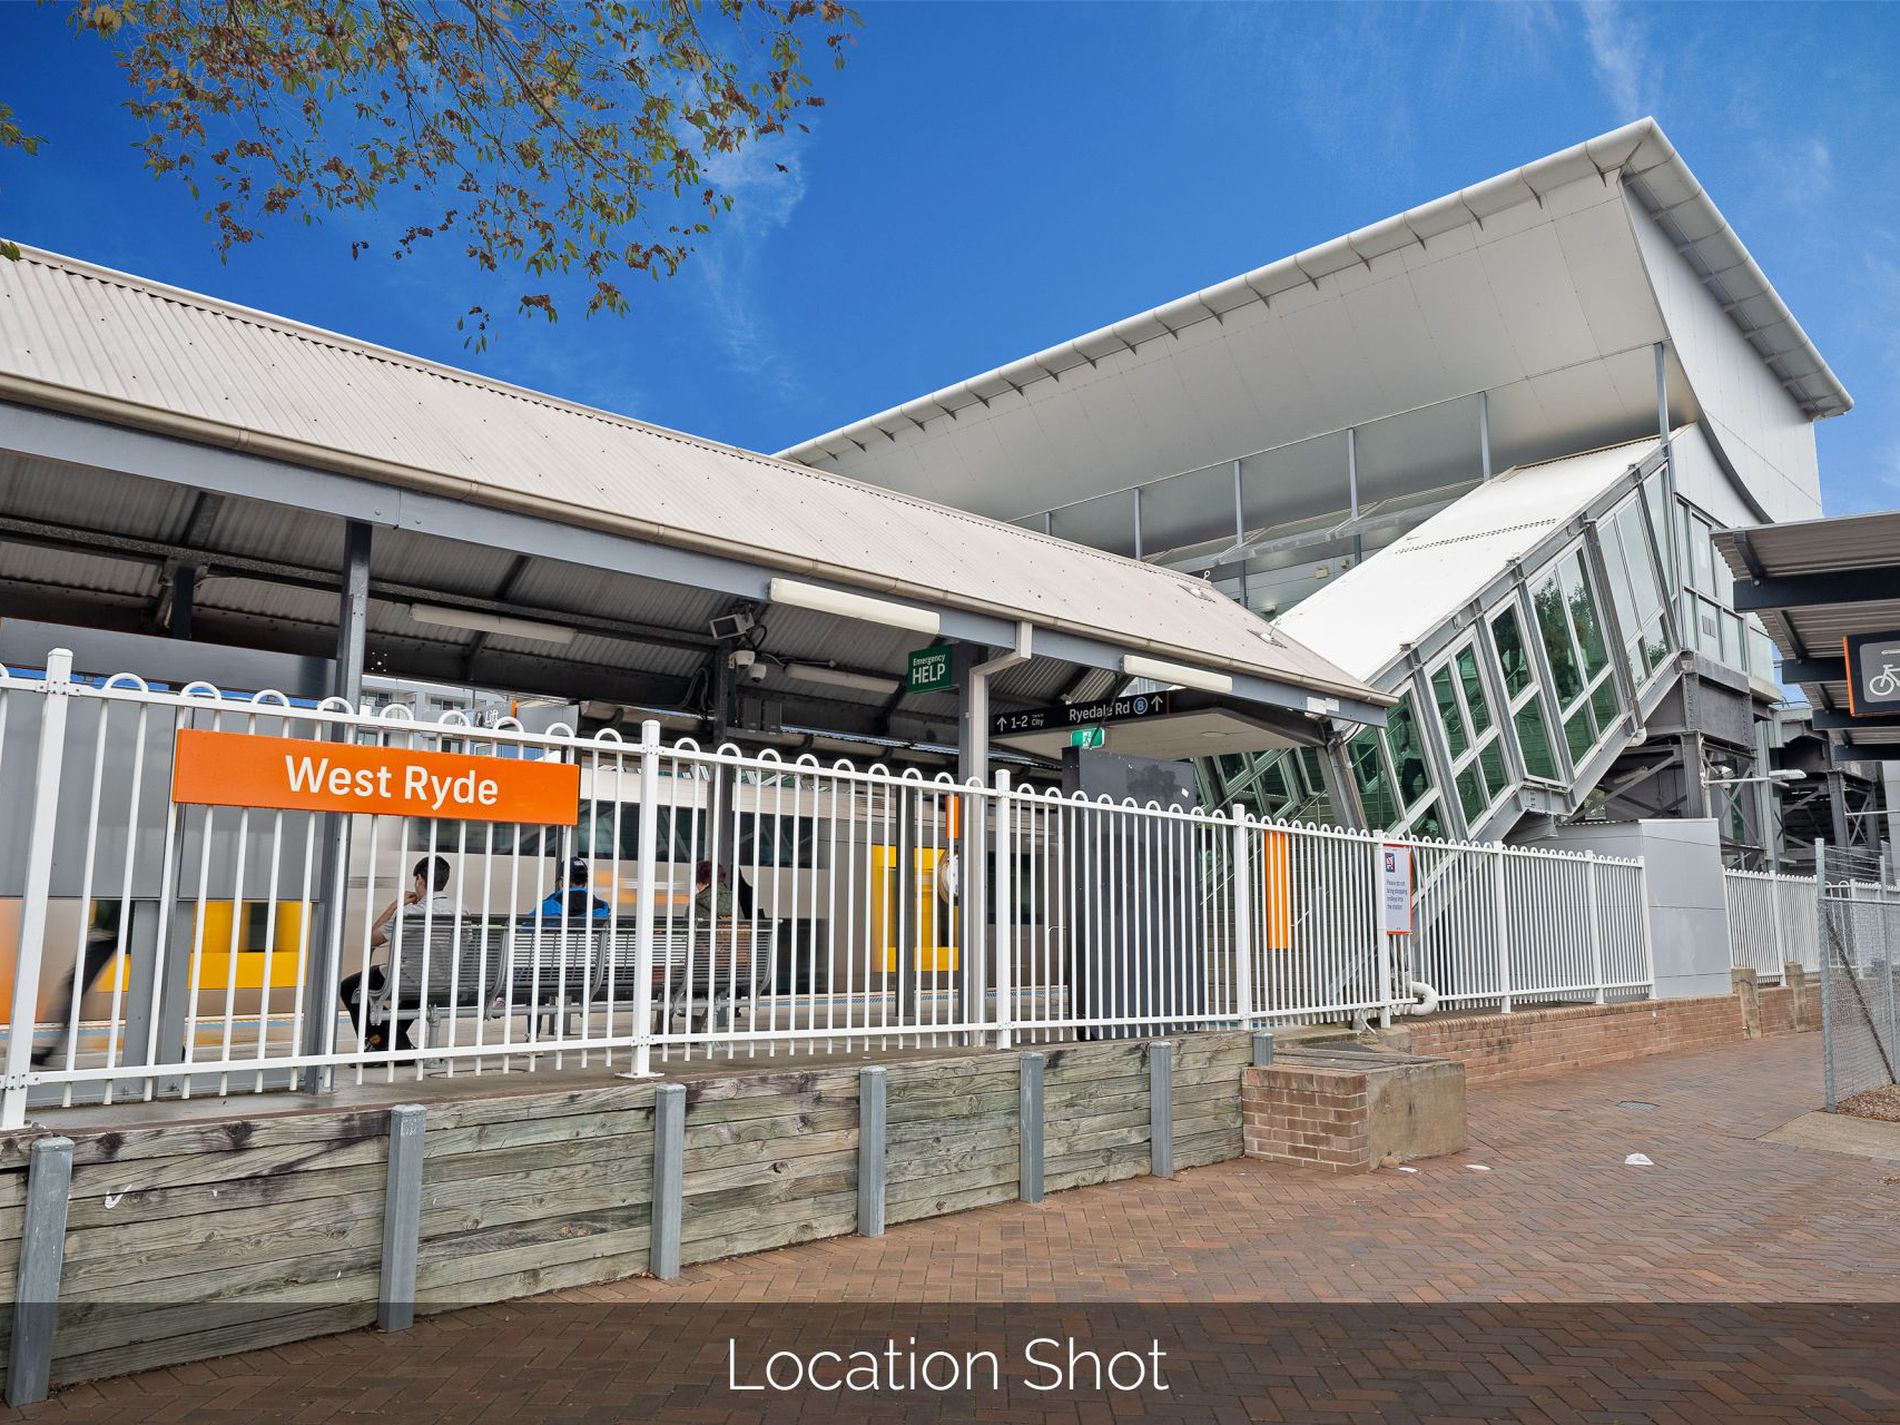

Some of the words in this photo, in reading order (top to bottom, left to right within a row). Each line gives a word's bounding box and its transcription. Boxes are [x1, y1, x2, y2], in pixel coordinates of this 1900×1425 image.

[913, 654, 946, 666] Emergency
[912, 663, 946, 685] HELP
[1115, 701, 1130, 715] Rd
[485, 709, 499, 724] Lift
[1011, 715, 1028, 729] 1-2
[1031, 718, 1044, 727] City
[285, 755, 392, 798] West
[404, 765, 498, 810] Ryde
